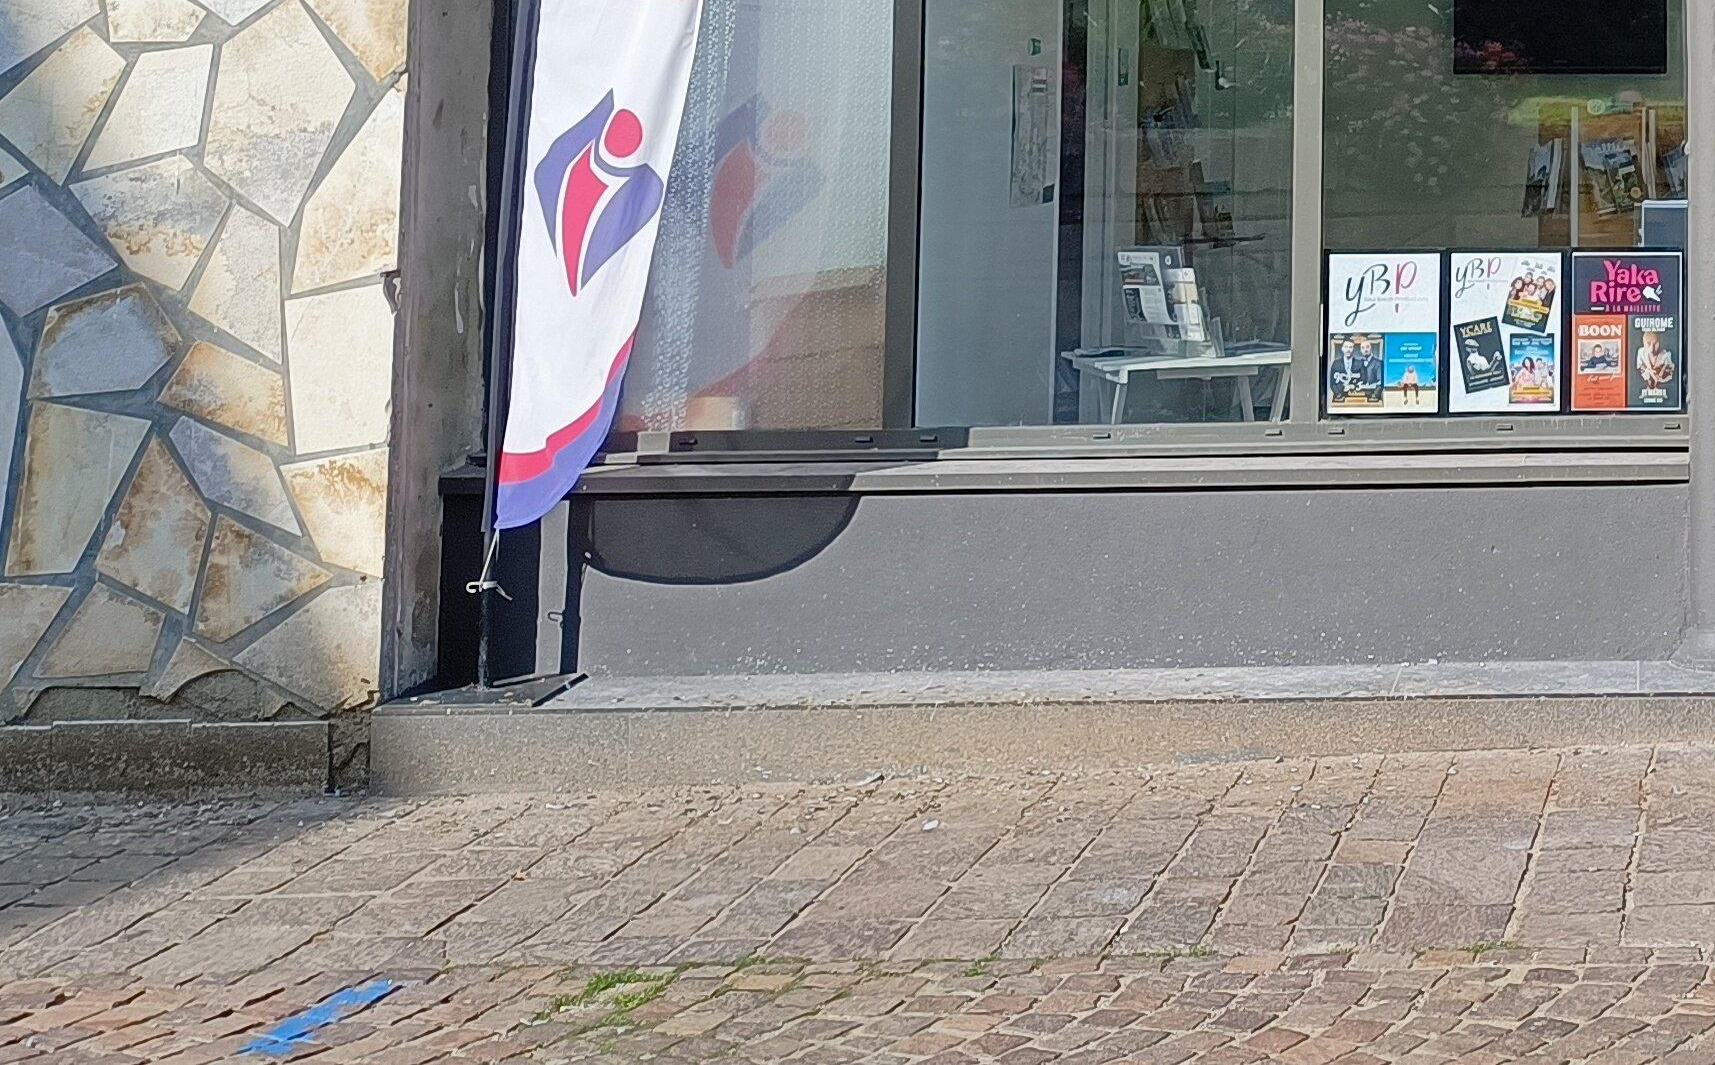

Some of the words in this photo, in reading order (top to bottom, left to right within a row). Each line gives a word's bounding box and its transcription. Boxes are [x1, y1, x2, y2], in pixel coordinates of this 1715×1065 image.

[1603, 259, 1660, 286] Yaka
[1590, 281, 1642, 304] Rire
[1577, 324, 1623, 337] BOON
